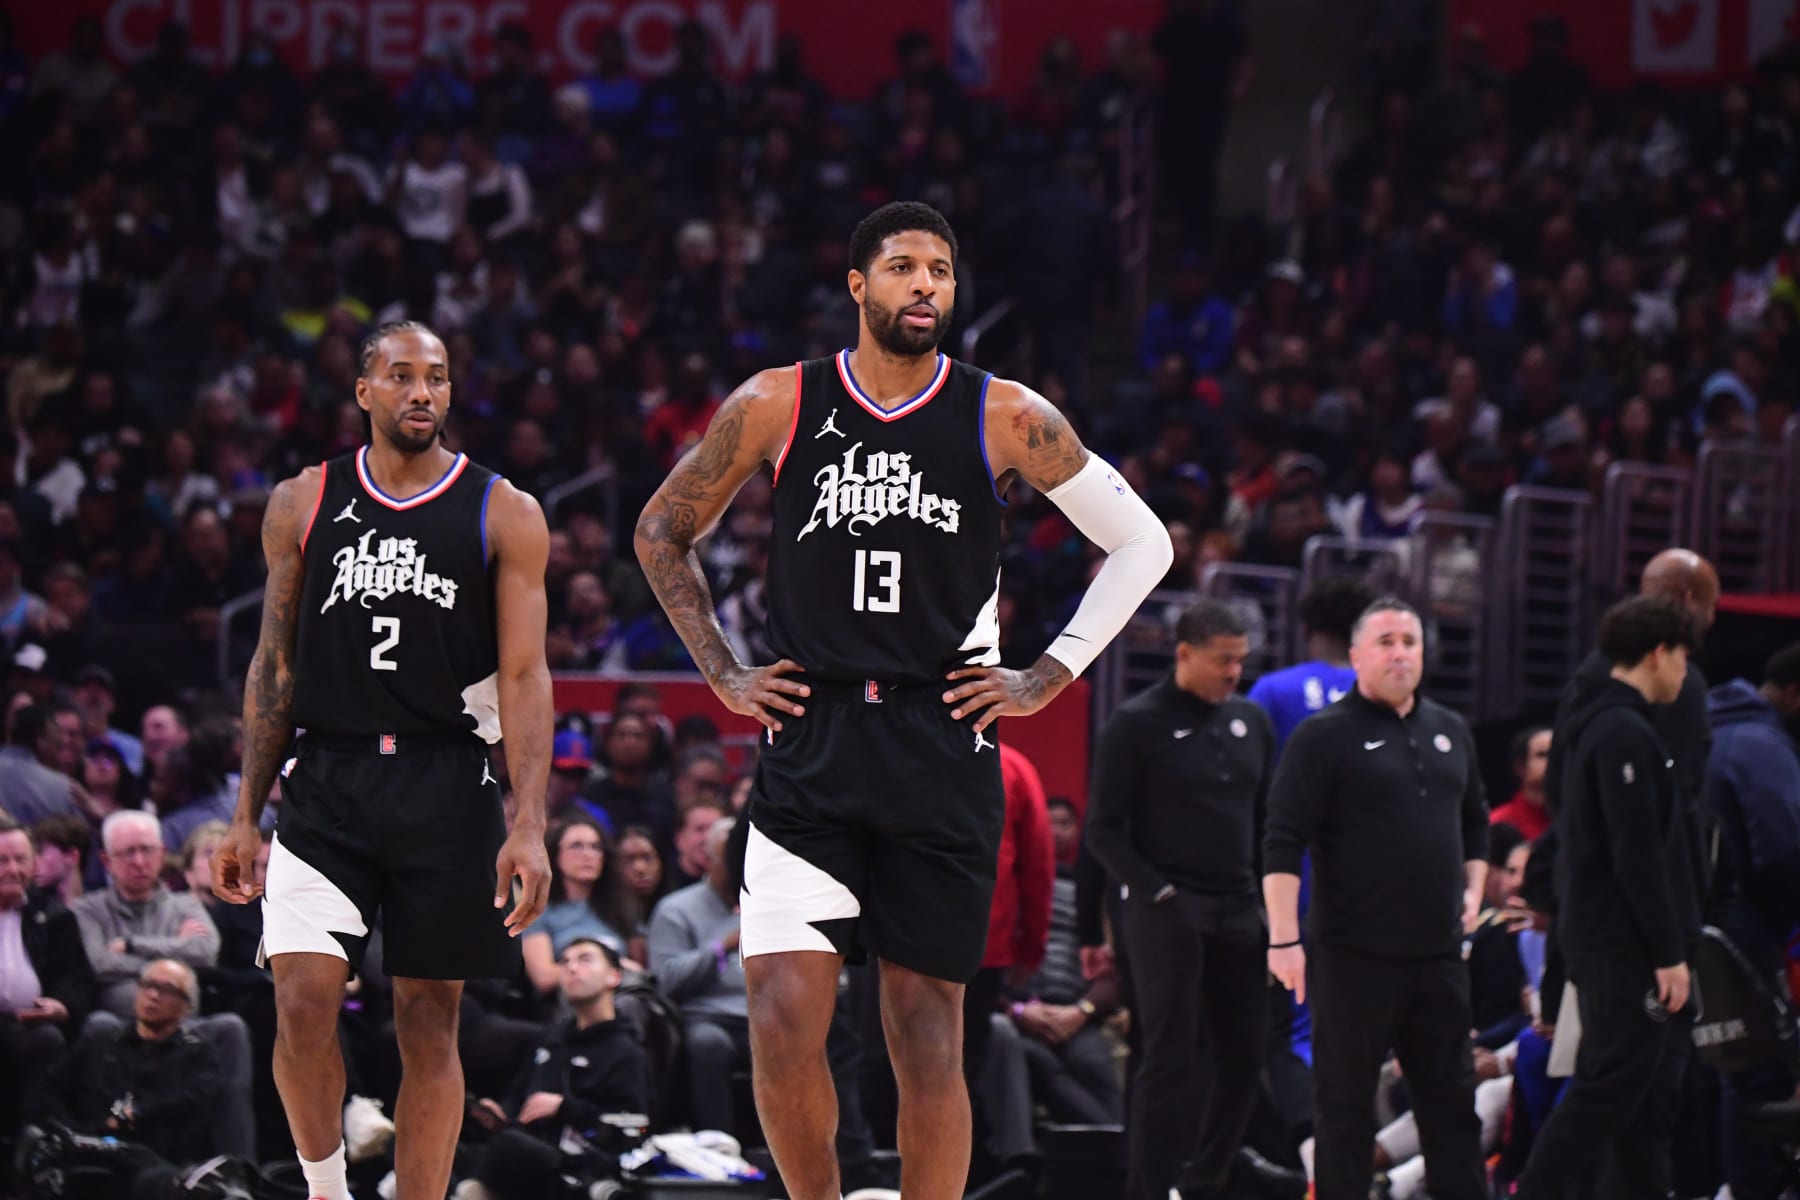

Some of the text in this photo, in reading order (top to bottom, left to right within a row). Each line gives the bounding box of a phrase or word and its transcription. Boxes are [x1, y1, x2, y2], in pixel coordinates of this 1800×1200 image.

[838, 441, 912, 485] Los
[797, 464, 962, 542] Angeles
[353, 528, 418, 566] Los
[320, 545, 459, 615] Angeles
[853, 549, 902, 613] 13
[370, 615, 401, 671] 2
